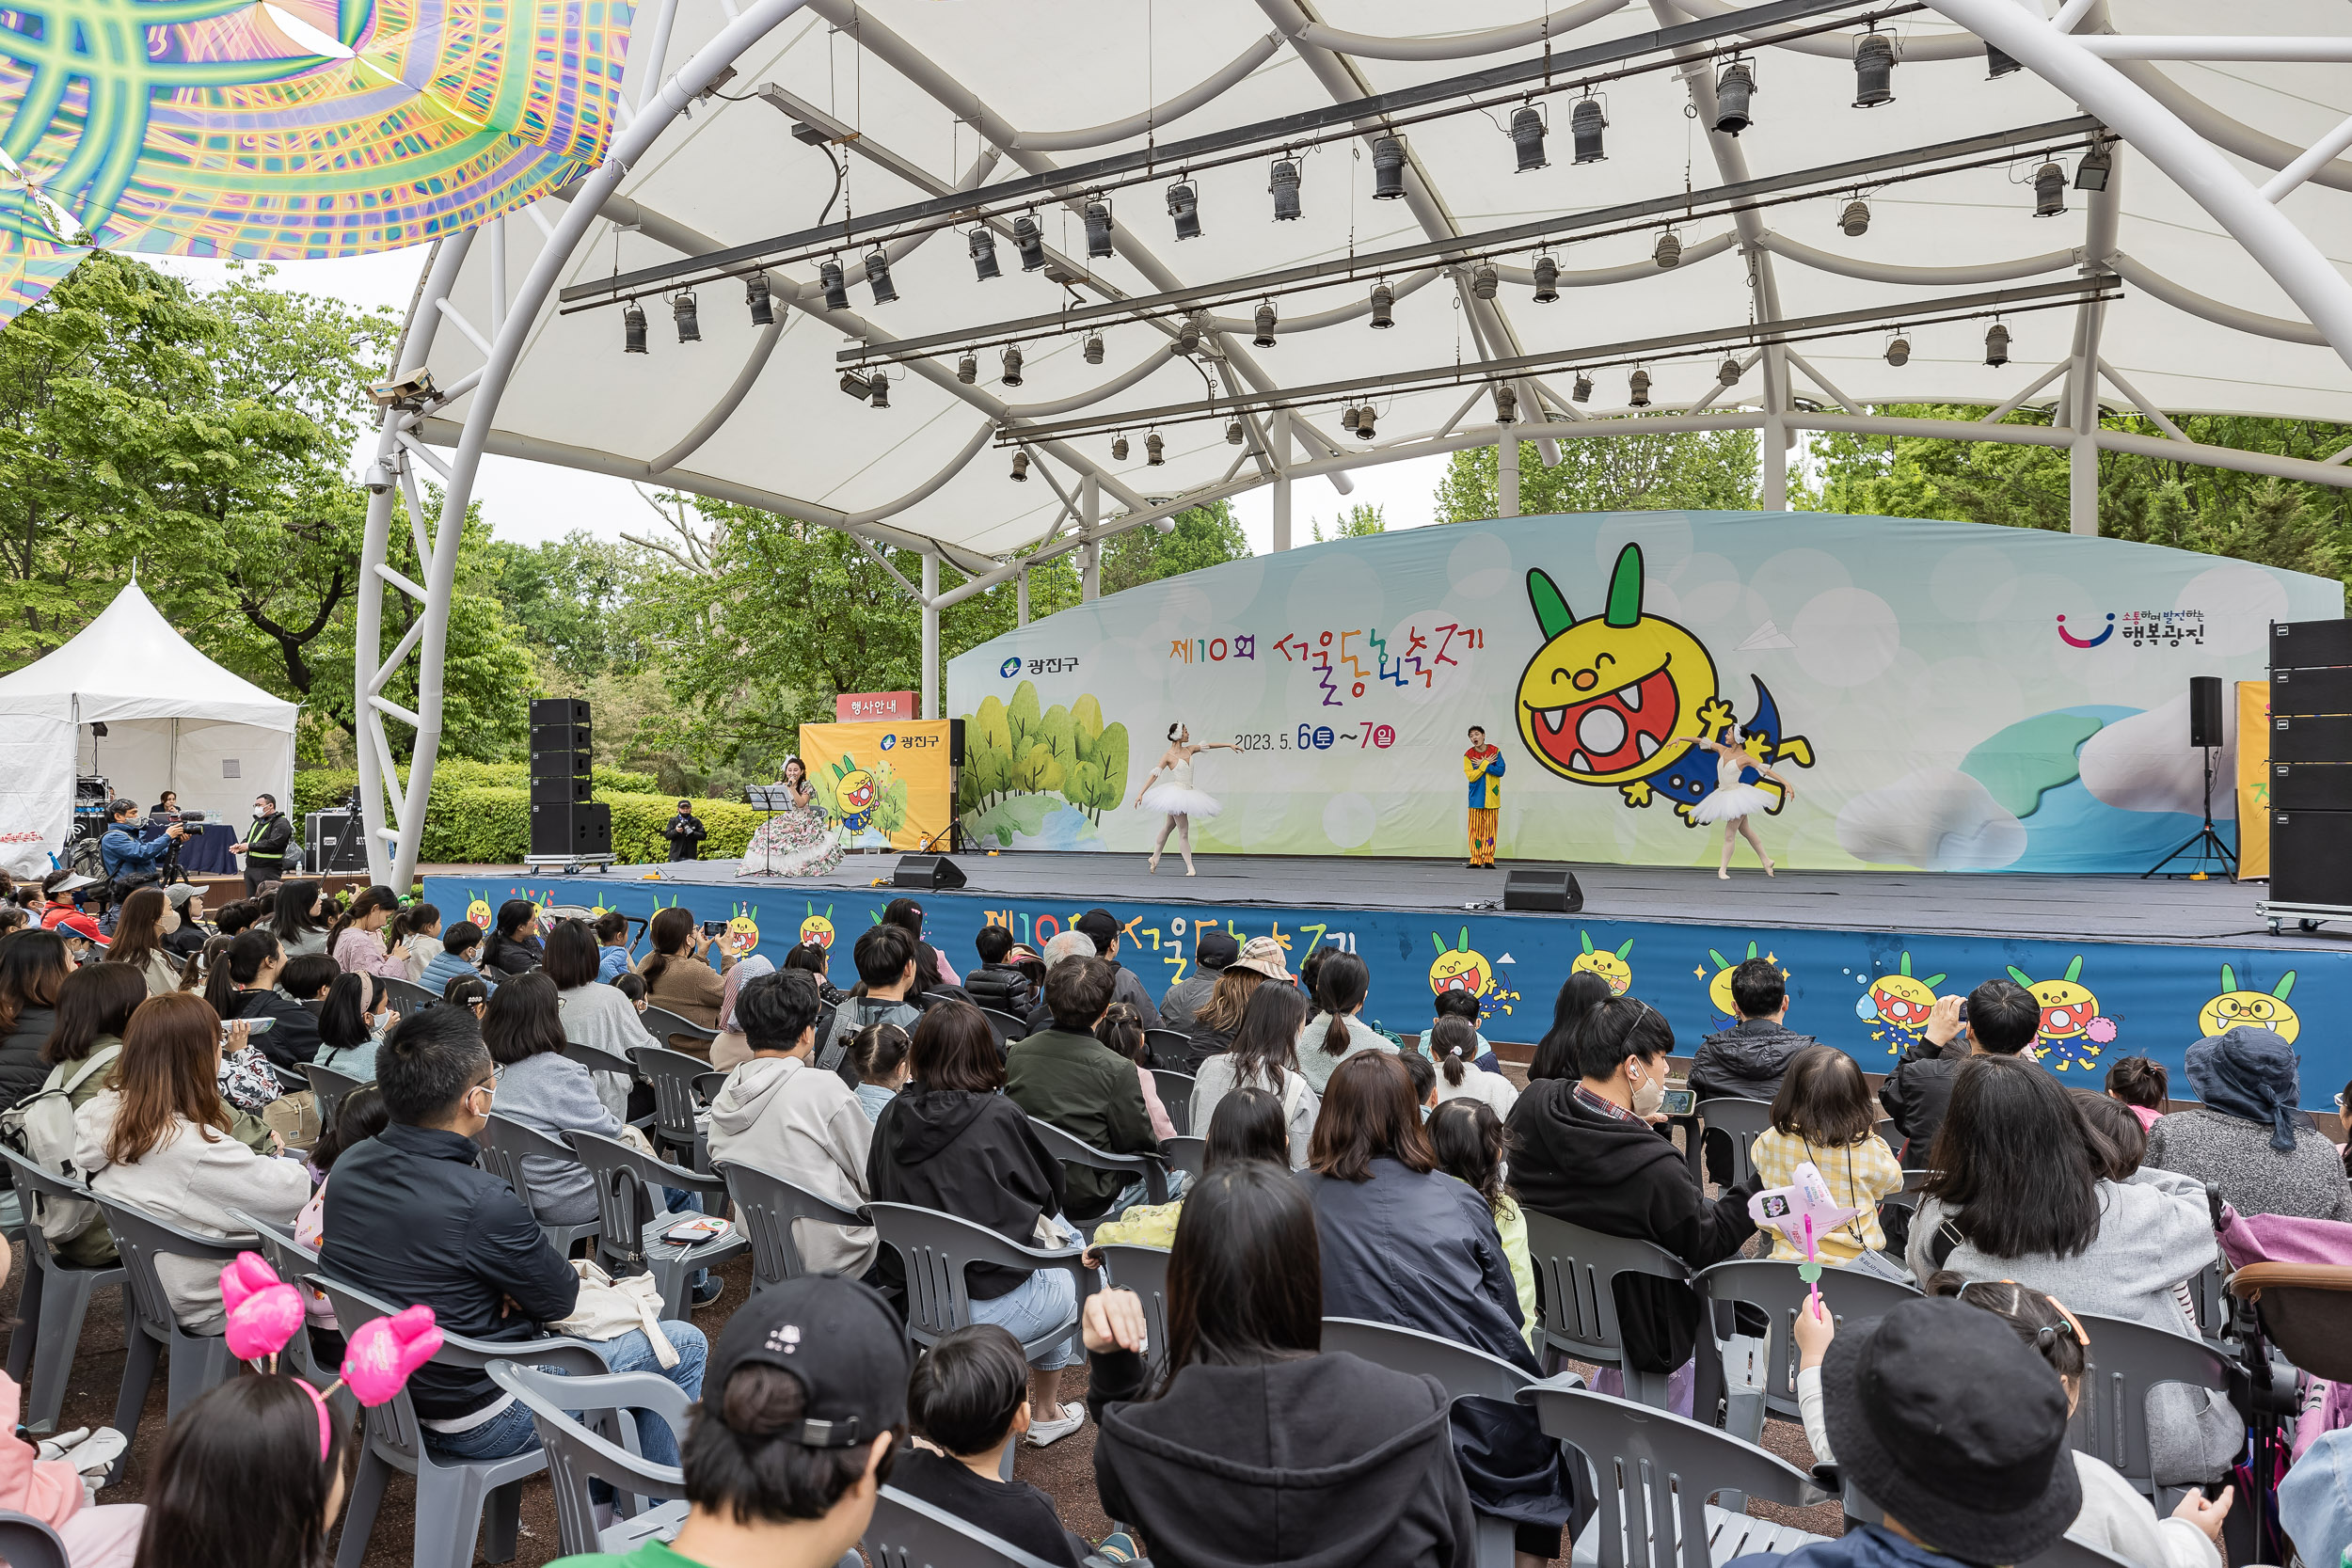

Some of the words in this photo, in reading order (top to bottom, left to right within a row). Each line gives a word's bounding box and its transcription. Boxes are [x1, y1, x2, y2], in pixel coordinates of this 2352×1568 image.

[2122, 610, 2161, 626] 소통하며
[2163, 610, 2204, 625] 발전하는
[2122, 623, 2204, 647] 행복광진
[1026, 657, 1079, 674] 광진구
[1169, 634, 1255, 664] 제10회
[1273, 623, 1485, 706] 서울동화축제
[850, 699, 897, 716] 행사안내
[900, 736, 940, 749] 광진구
